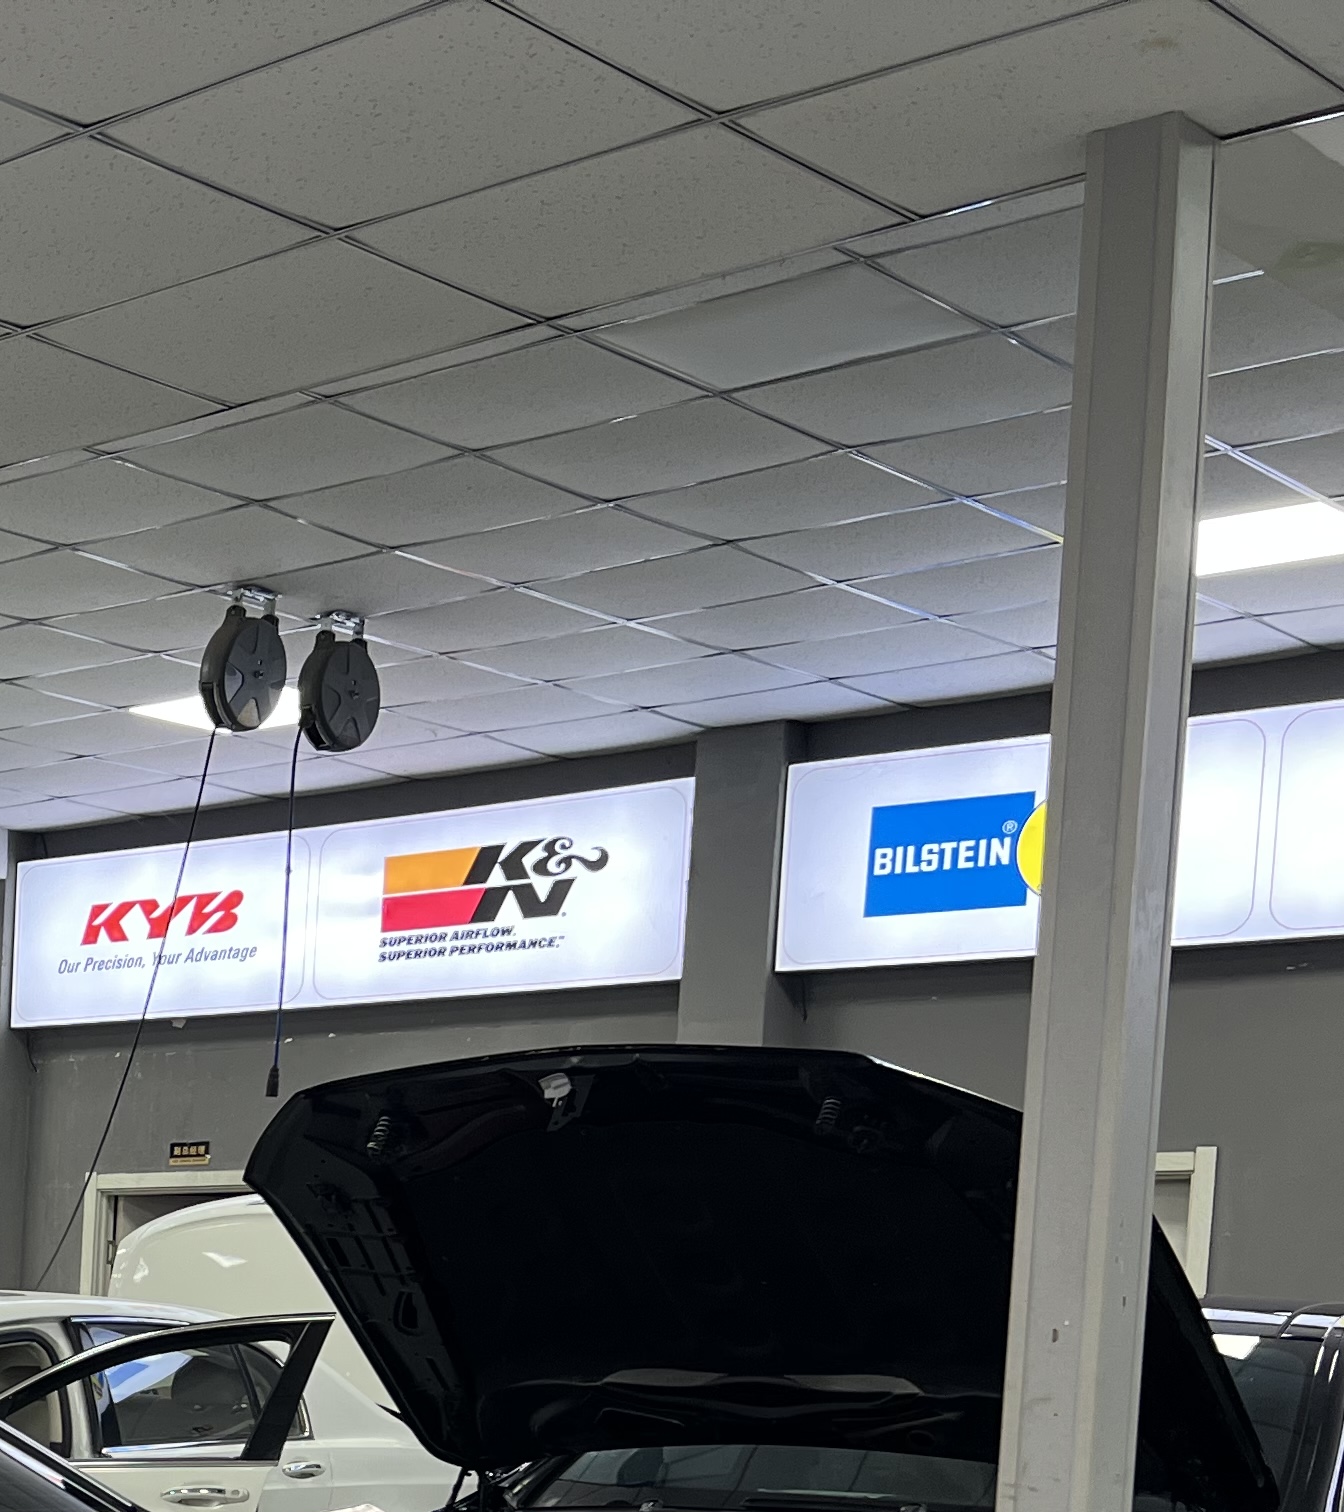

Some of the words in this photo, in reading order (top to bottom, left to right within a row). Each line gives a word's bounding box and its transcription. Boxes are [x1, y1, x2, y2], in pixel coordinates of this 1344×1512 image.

[873, 836, 1011, 876] BILSTEIN
[80, 890, 244, 946] KYB
[378, 946, 446, 963] SUPERIOR
[379, 931, 447, 948] SUPERIOR
[58, 959, 81, 975] Our
[83, 954, 145, 973] Precision,
[152, 951, 182, 967] Your
[184, 945, 257, 964] Advantage
